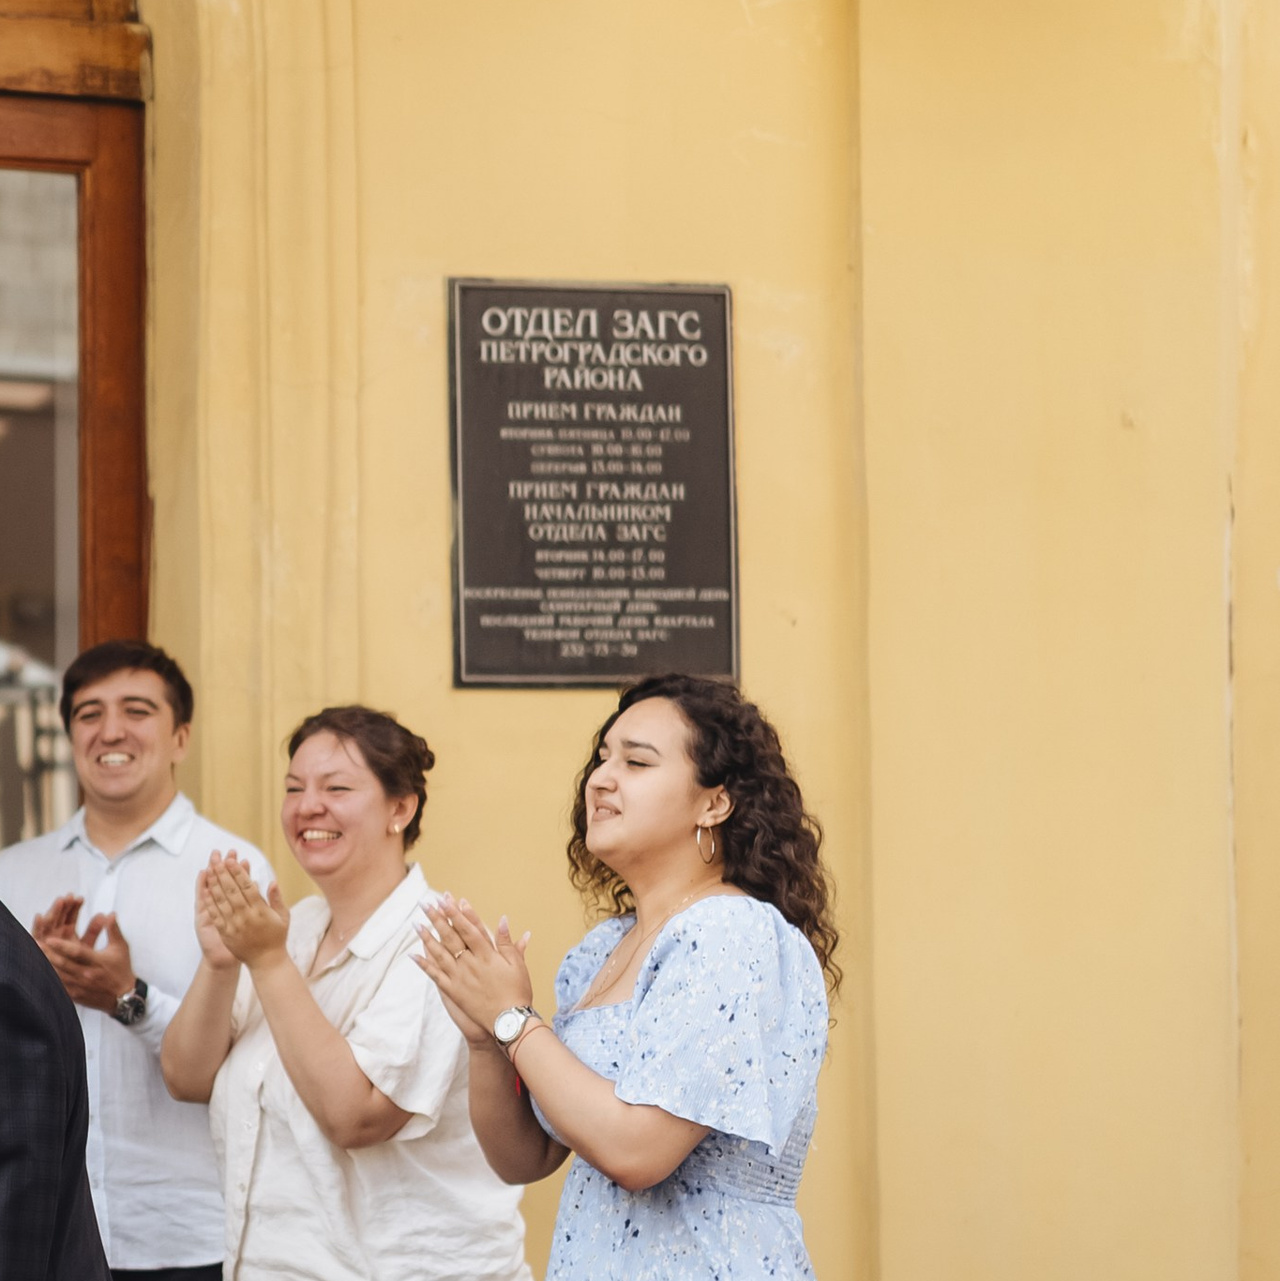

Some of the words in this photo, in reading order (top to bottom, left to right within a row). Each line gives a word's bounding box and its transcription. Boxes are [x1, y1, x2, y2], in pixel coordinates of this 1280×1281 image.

[481, 307, 598, 341] ОТДЕЛ
[613, 309, 702, 340] ЗАГС
[480, 339, 708, 368] ПЕТРОГРАДСКОГО
[543, 365, 643, 391] РАЙОНА
[507, 401, 577, 421] ПРИЕМ
[584, 402, 682, 424] ГРАЖДАН
[508, 481, 577, 500] ПРИЕМ
[585, 482, 684, 502] ГРАЖДАН
[523, 502, 672, 522] НАЧАЛЬНИКОМ
[528, 522, 606, 543] ОТДЕЛА
[616, 523, 666, 542] ЗАГС
